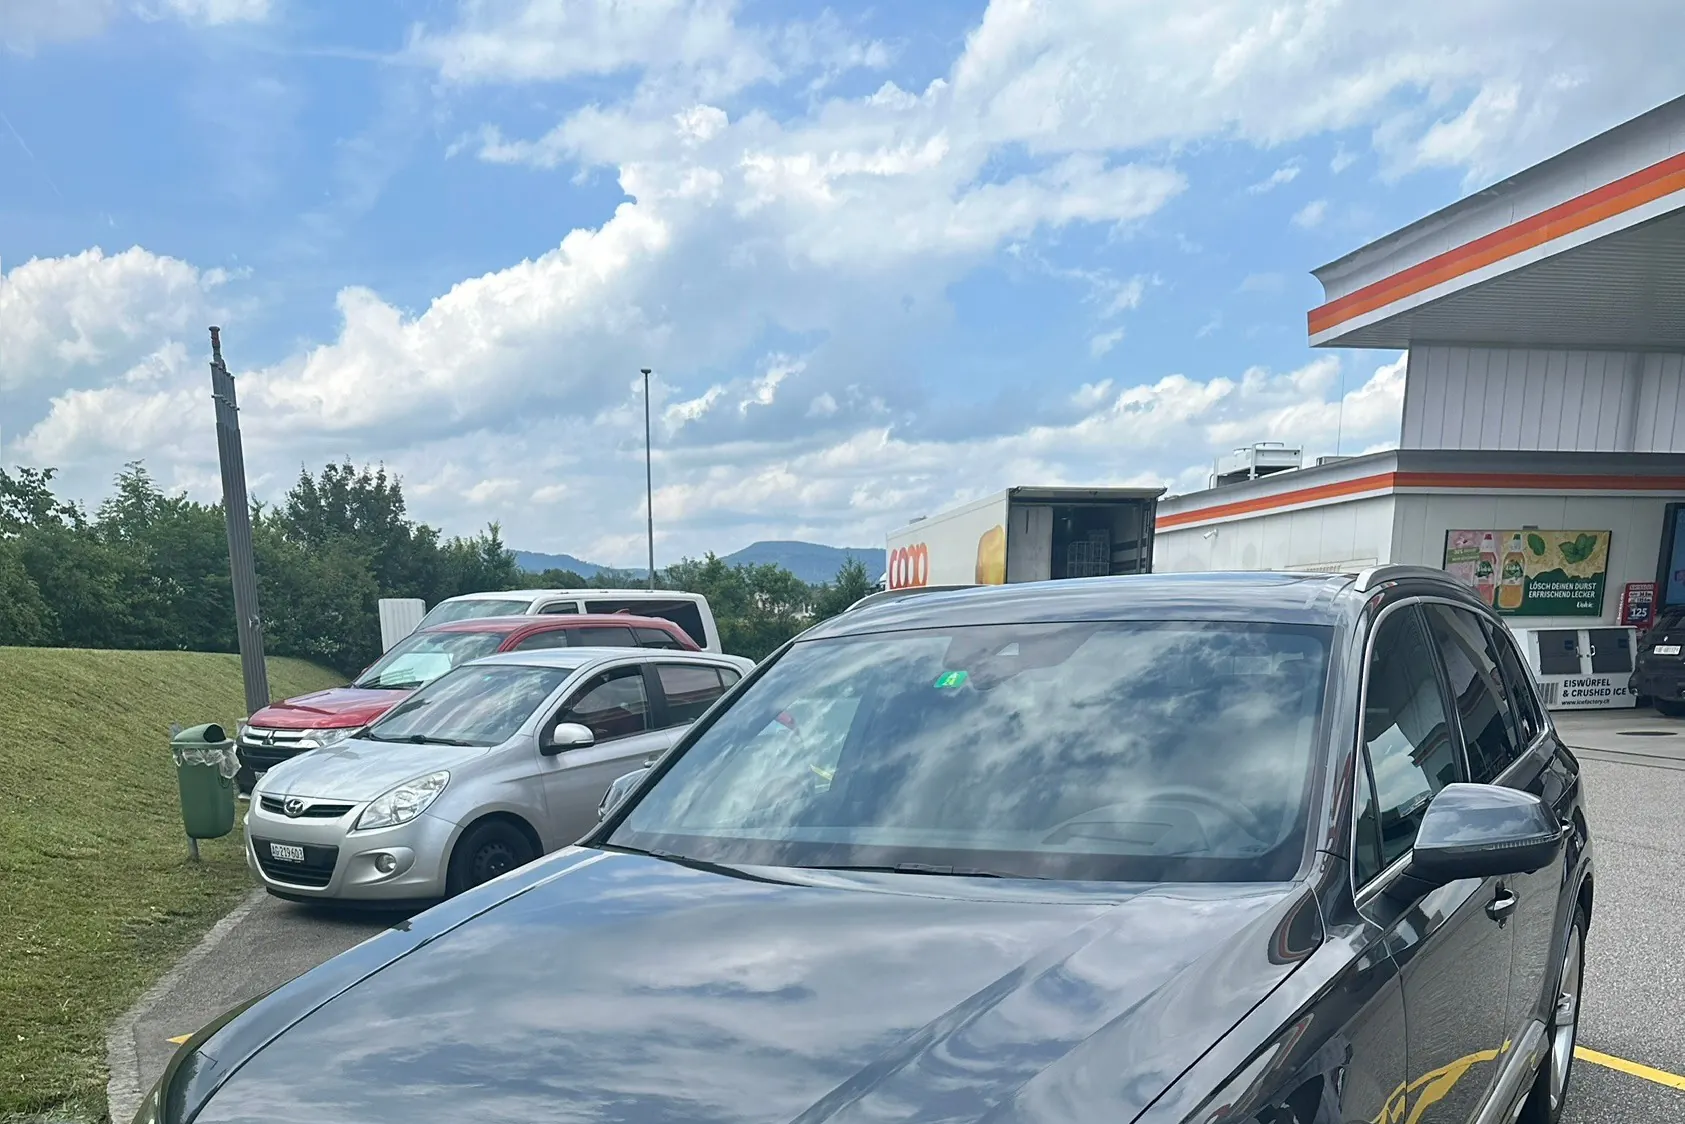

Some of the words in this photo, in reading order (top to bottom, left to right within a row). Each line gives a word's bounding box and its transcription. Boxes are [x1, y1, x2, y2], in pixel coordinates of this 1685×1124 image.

[1529, 581, 1551, 590] LÖSCH
[1552, 582, 1574, 590] DEINEN
[1574, 582, 1597, 590] DURST
[1528, 590, 1571, 598] ERFRISCHEND
[1571, 590, 1595, 598] LECKER
[1563, 678, 1611, 687] EISWÜRFEL
[1571, 688, 1611, 697] CRUSHED
[1612, 687, 1627, 696] ICE
